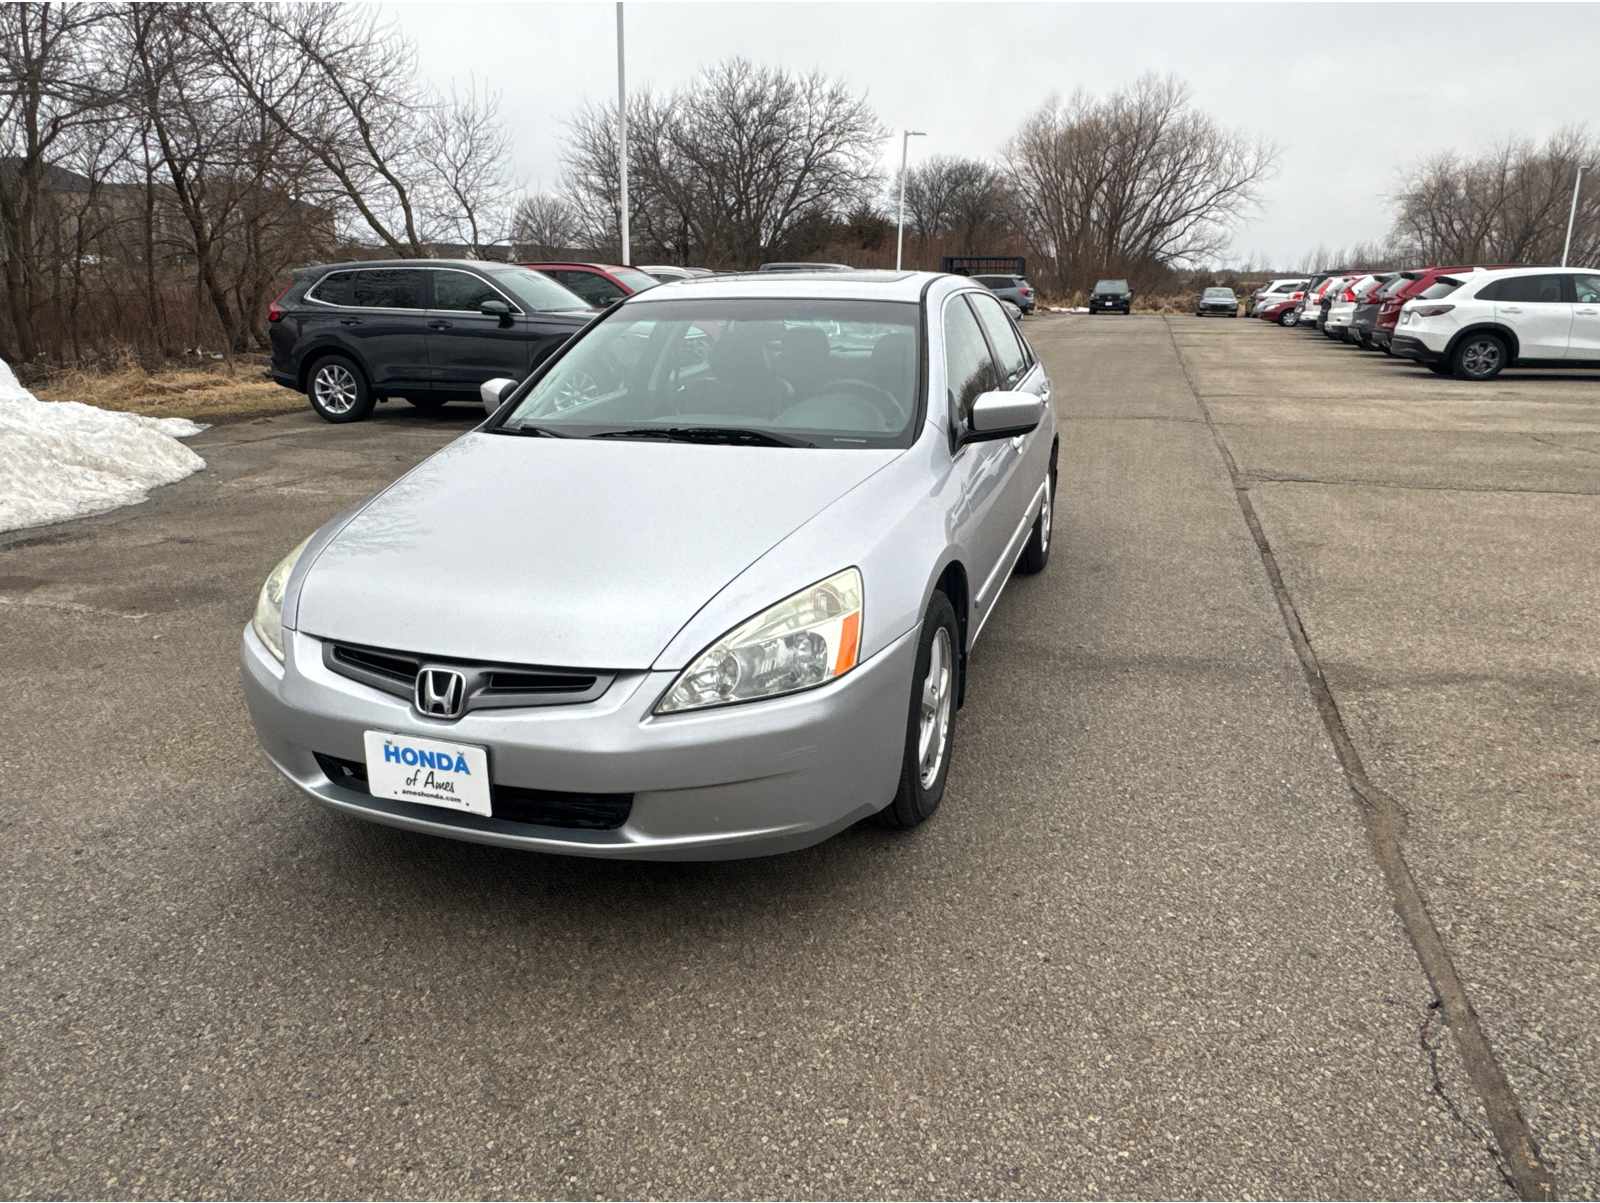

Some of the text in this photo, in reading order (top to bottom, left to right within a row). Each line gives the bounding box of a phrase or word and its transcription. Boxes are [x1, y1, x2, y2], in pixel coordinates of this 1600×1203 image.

[384, 744, 471, 776] HONDA
[405, 769, 455, 793] of Ames
[402, 789, 462, 803] ameshonda.com
